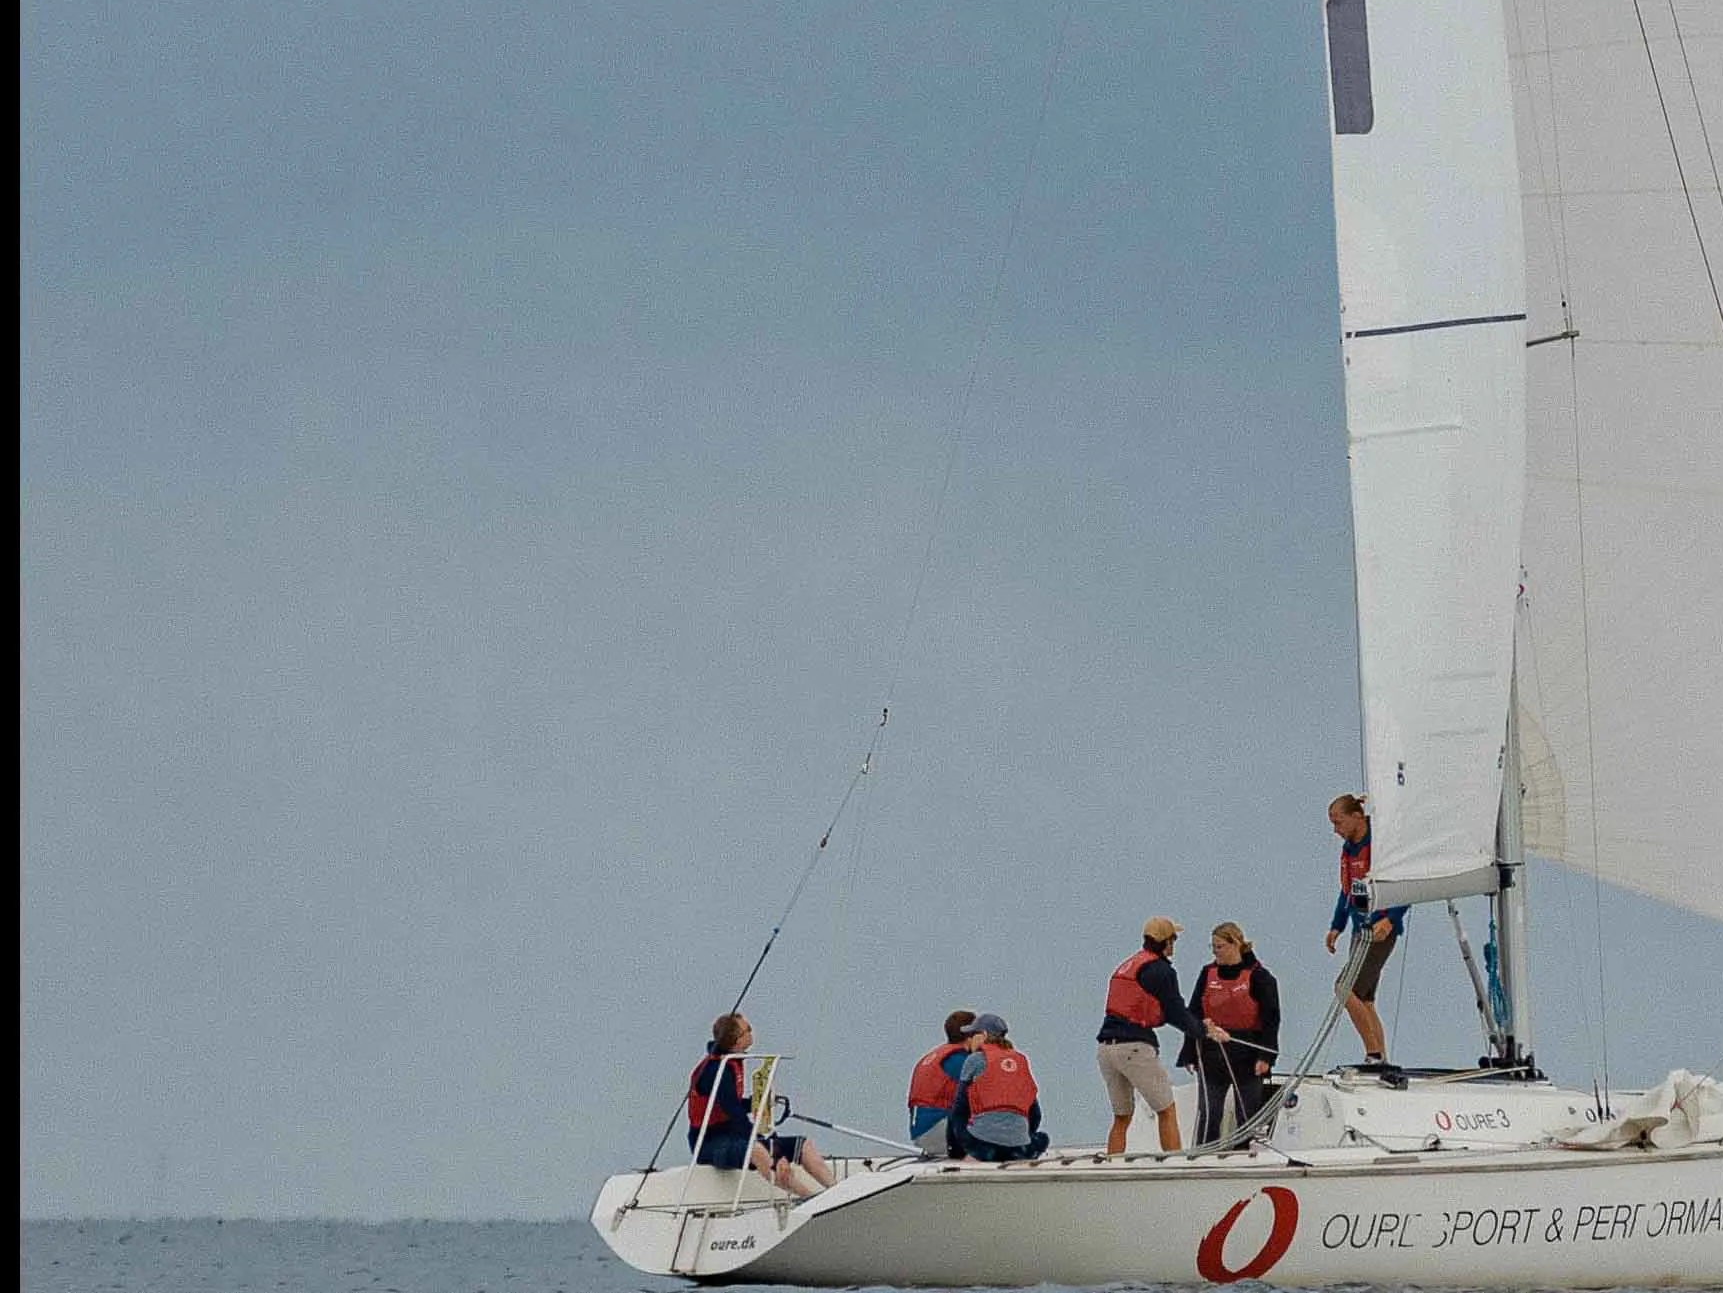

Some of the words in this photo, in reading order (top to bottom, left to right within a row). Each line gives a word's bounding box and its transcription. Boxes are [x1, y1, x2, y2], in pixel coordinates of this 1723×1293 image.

[1496, 1108, 1511, 1128] 3
[1544, 1207, 1565, 1243] &
[710, 1235, 757, 1251] oure.dk
